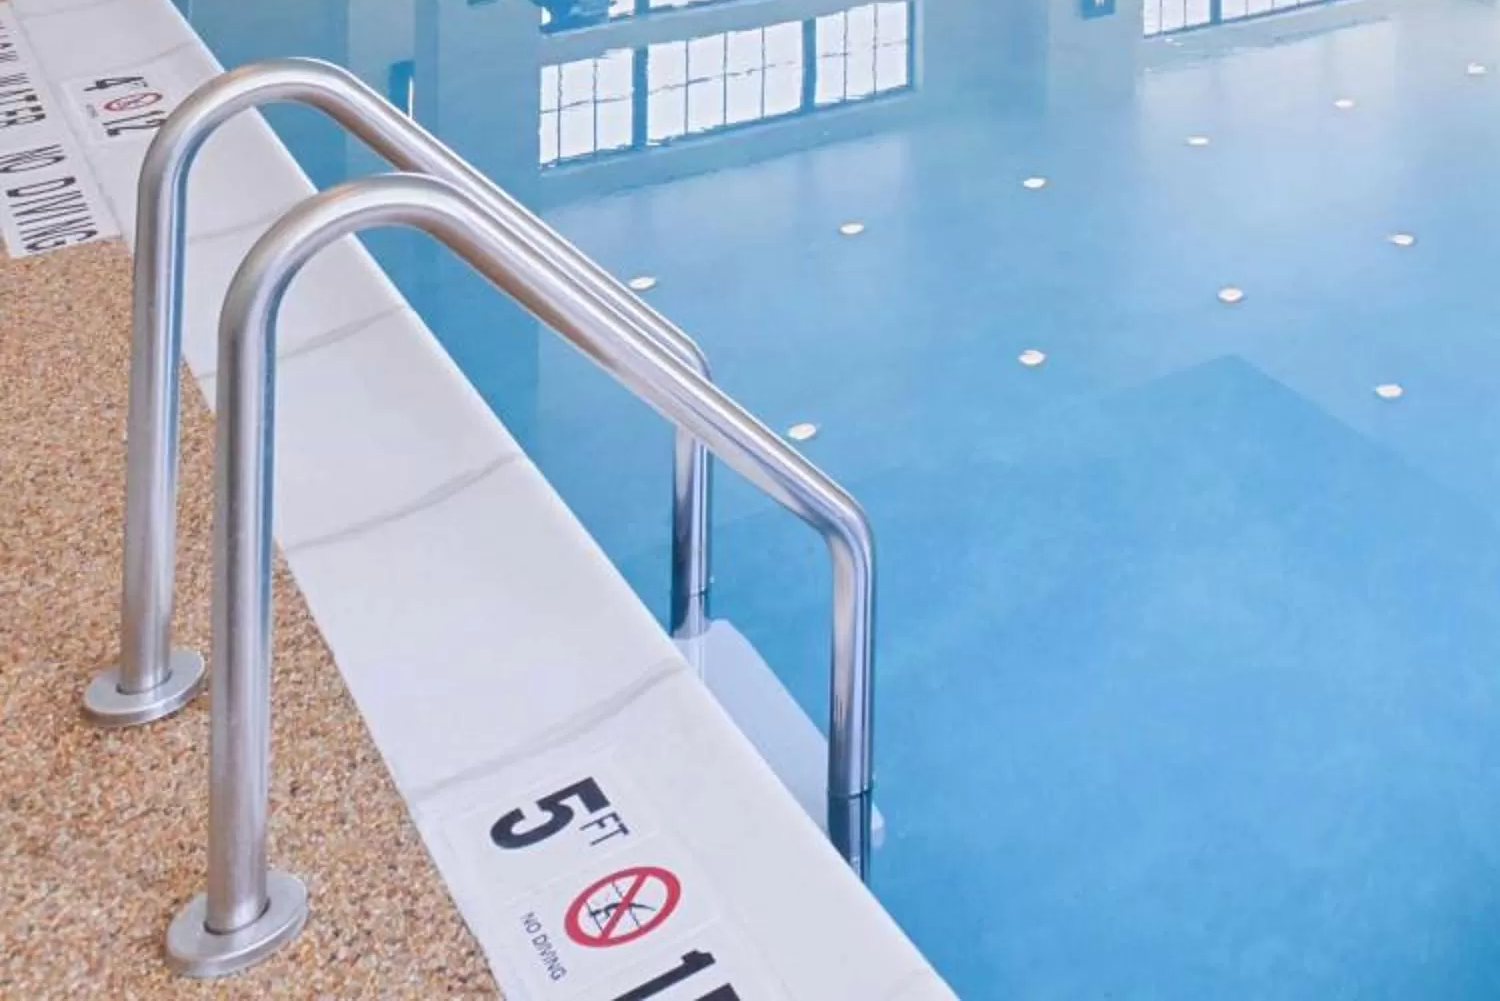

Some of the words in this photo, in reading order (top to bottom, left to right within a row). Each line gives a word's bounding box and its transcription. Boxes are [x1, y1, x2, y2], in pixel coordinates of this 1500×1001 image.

[6, 177, 98, 250] DIVING
[489, 776, 611, 850] 5
[579, 811, 630, 846] FT
[521, 911, 541, 934] NO
[532, 933, 567, 981] DIVING
